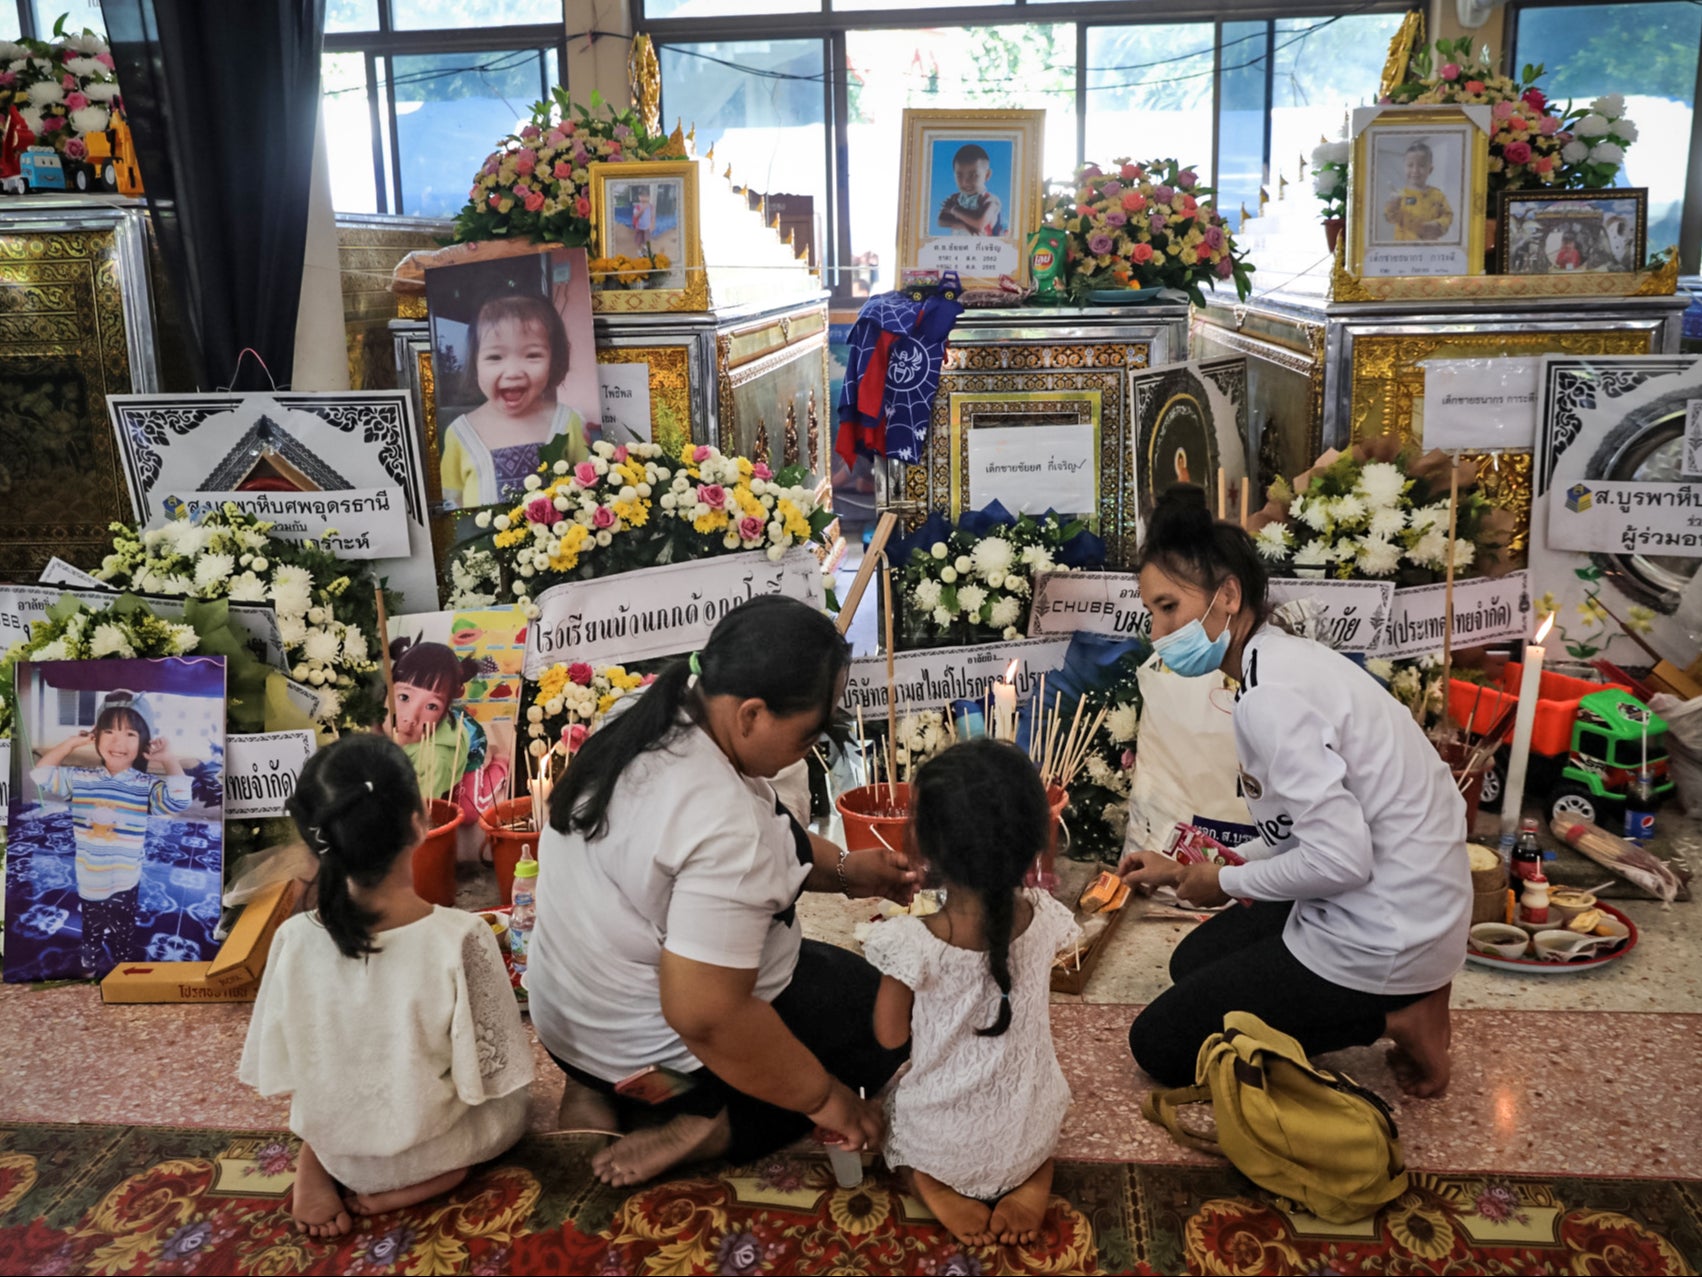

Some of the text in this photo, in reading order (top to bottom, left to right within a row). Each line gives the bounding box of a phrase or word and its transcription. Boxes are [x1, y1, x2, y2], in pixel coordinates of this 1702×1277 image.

[187, 488, 390, 522] ส.บพาหีบศพอุดรธานี
[1621, 524, 1702, 551] ผู้ร่วมอ
[1052, 600, 1115, 616] CHUBB
